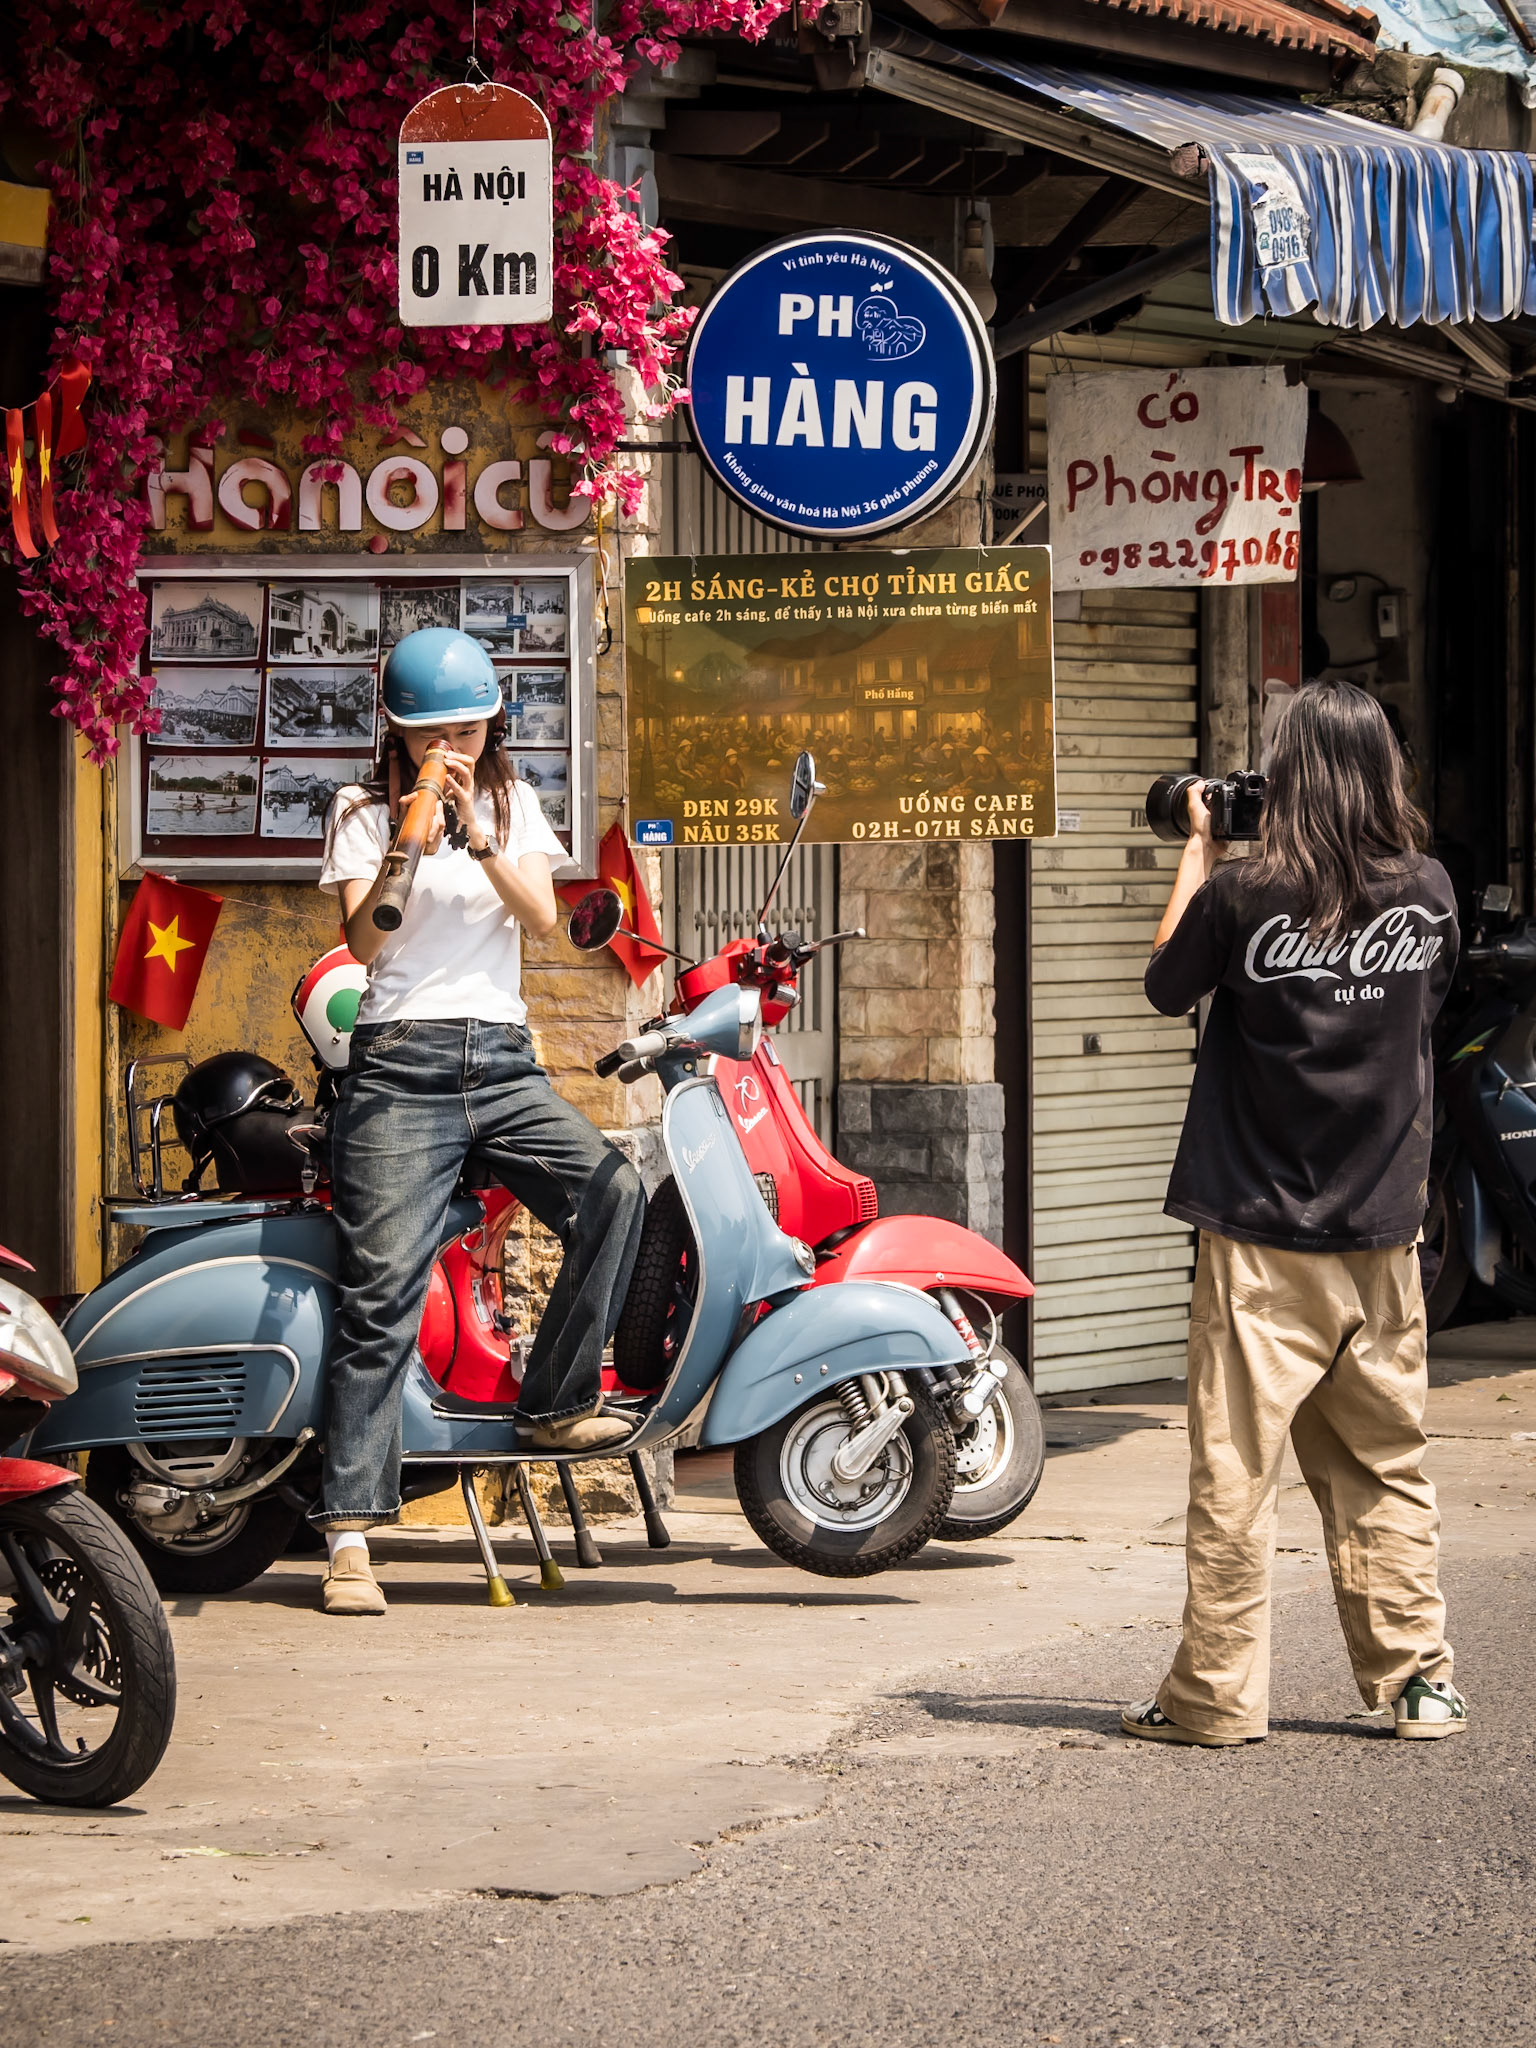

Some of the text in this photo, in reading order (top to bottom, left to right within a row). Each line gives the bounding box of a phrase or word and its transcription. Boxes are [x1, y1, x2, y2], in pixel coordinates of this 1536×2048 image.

[424, 166, 525, 206] HÀ NỘI
[412, 244, 537, 297] 0 Km
[782, 252, 891, 275] Vì tình yêu Hà Nội
[724, 362, 938, 451] HÀNG
[1137, 373, 1199, 429] Có
[723, 452, 752, 487] Không
[749, 483, 775, 502] gian
[776, 498, 796, 512] văn
[798, 504, 820, 517] hoá
[823, 507, 838, 518] Hà
[841, 505, 861, 518] Nội
[863, 500, 878, 513] 36
[880, 487, 901, 509] phố
[646, 581, 681, 601] 2H
[824, 573, 879, 602] CHỢ
[888, 566, 957, 595] TỈNH
[965, 563, 1030, 592] GIẤC
[649, 600, 1037, 624] Uống cafe 2h sáng, để thấy 1 Hà Nội xưa chưa từng biến mất
[865, 688, 885, 699] Phố
[683, 798, 779, 818] ĐEN 29K
[899, 790, 1035, 814] UỐNG CAFE
[643, 831, 667, 841] HÀNG
[683, 820, 780, 842] NÂU 35K
[852, 820, 961, 838] 02H-07H
[970, 813, 1035, 836] SÁNG
[1334, 984, 1385, 1005] tự do
